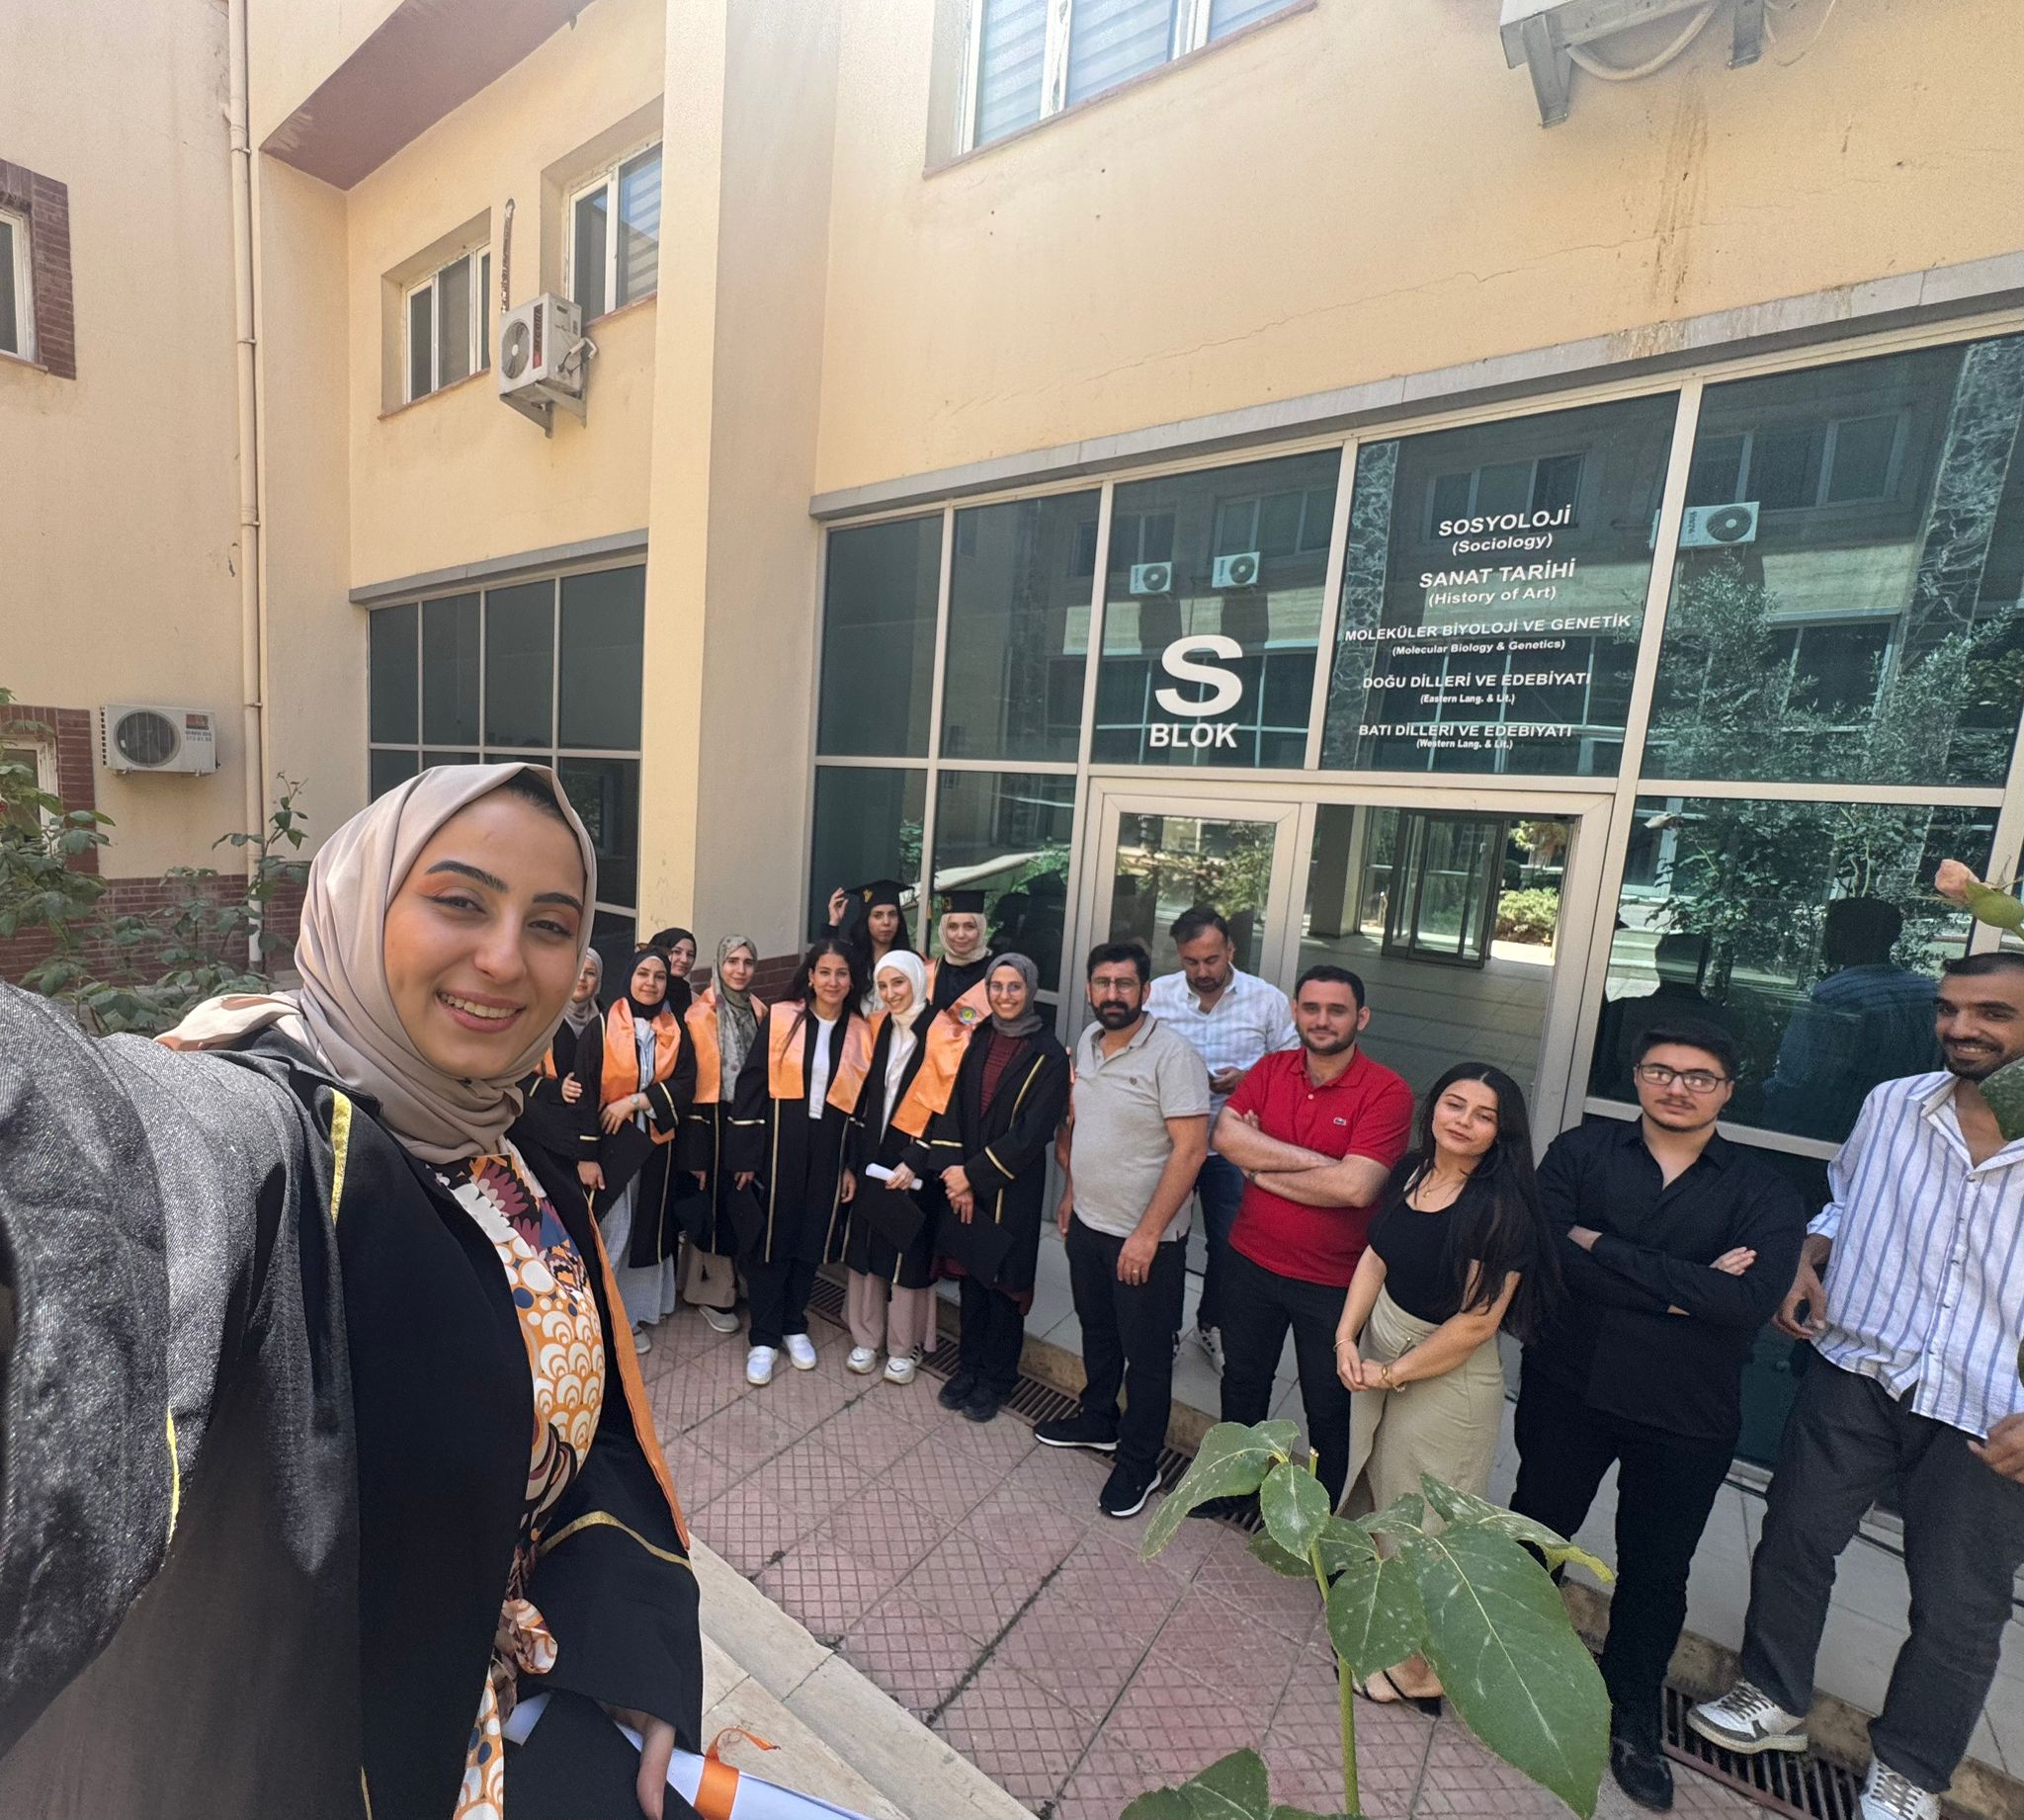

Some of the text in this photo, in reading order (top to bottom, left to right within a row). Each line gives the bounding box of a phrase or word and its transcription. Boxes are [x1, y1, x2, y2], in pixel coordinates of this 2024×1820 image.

[1439, 504, 1571, 537] SOSYOLOJİ
[1452, 534, 1553, 556] (Sociology)
[1419, 557, 1575, 589] SANAT TARİHİ
[1428, 586, 1557, 608] (History of Art)
[1345, 613, 1632, 642] MOLEKÜLER BİYOLOJİ VE GENETİK
[1392, 638, 1566, 657] (Molecular Biology & Genetics)
[1155, 634, 1243, 717] S
[1363, 670, 1591, 689] DOĞU DİLLERİ VE EDEBİYATI
[1420, 694, 1458, 704] (Eastern
[1459, 694, 1484, 704] Lang.
[1486, 694, 1494, 703] &
[1149, 722, 1238, 748] BLOK
[1359, 724, 1392, 736] BATI
[1394, 722, 1454, 737] DİLLERİ
[1458, 724, 1479, 737] VE
[1416, 738, 1456, 750] (Western
[1457, 739, 1482, 751] Lang.
[1484, 739, 1492, 749] &
